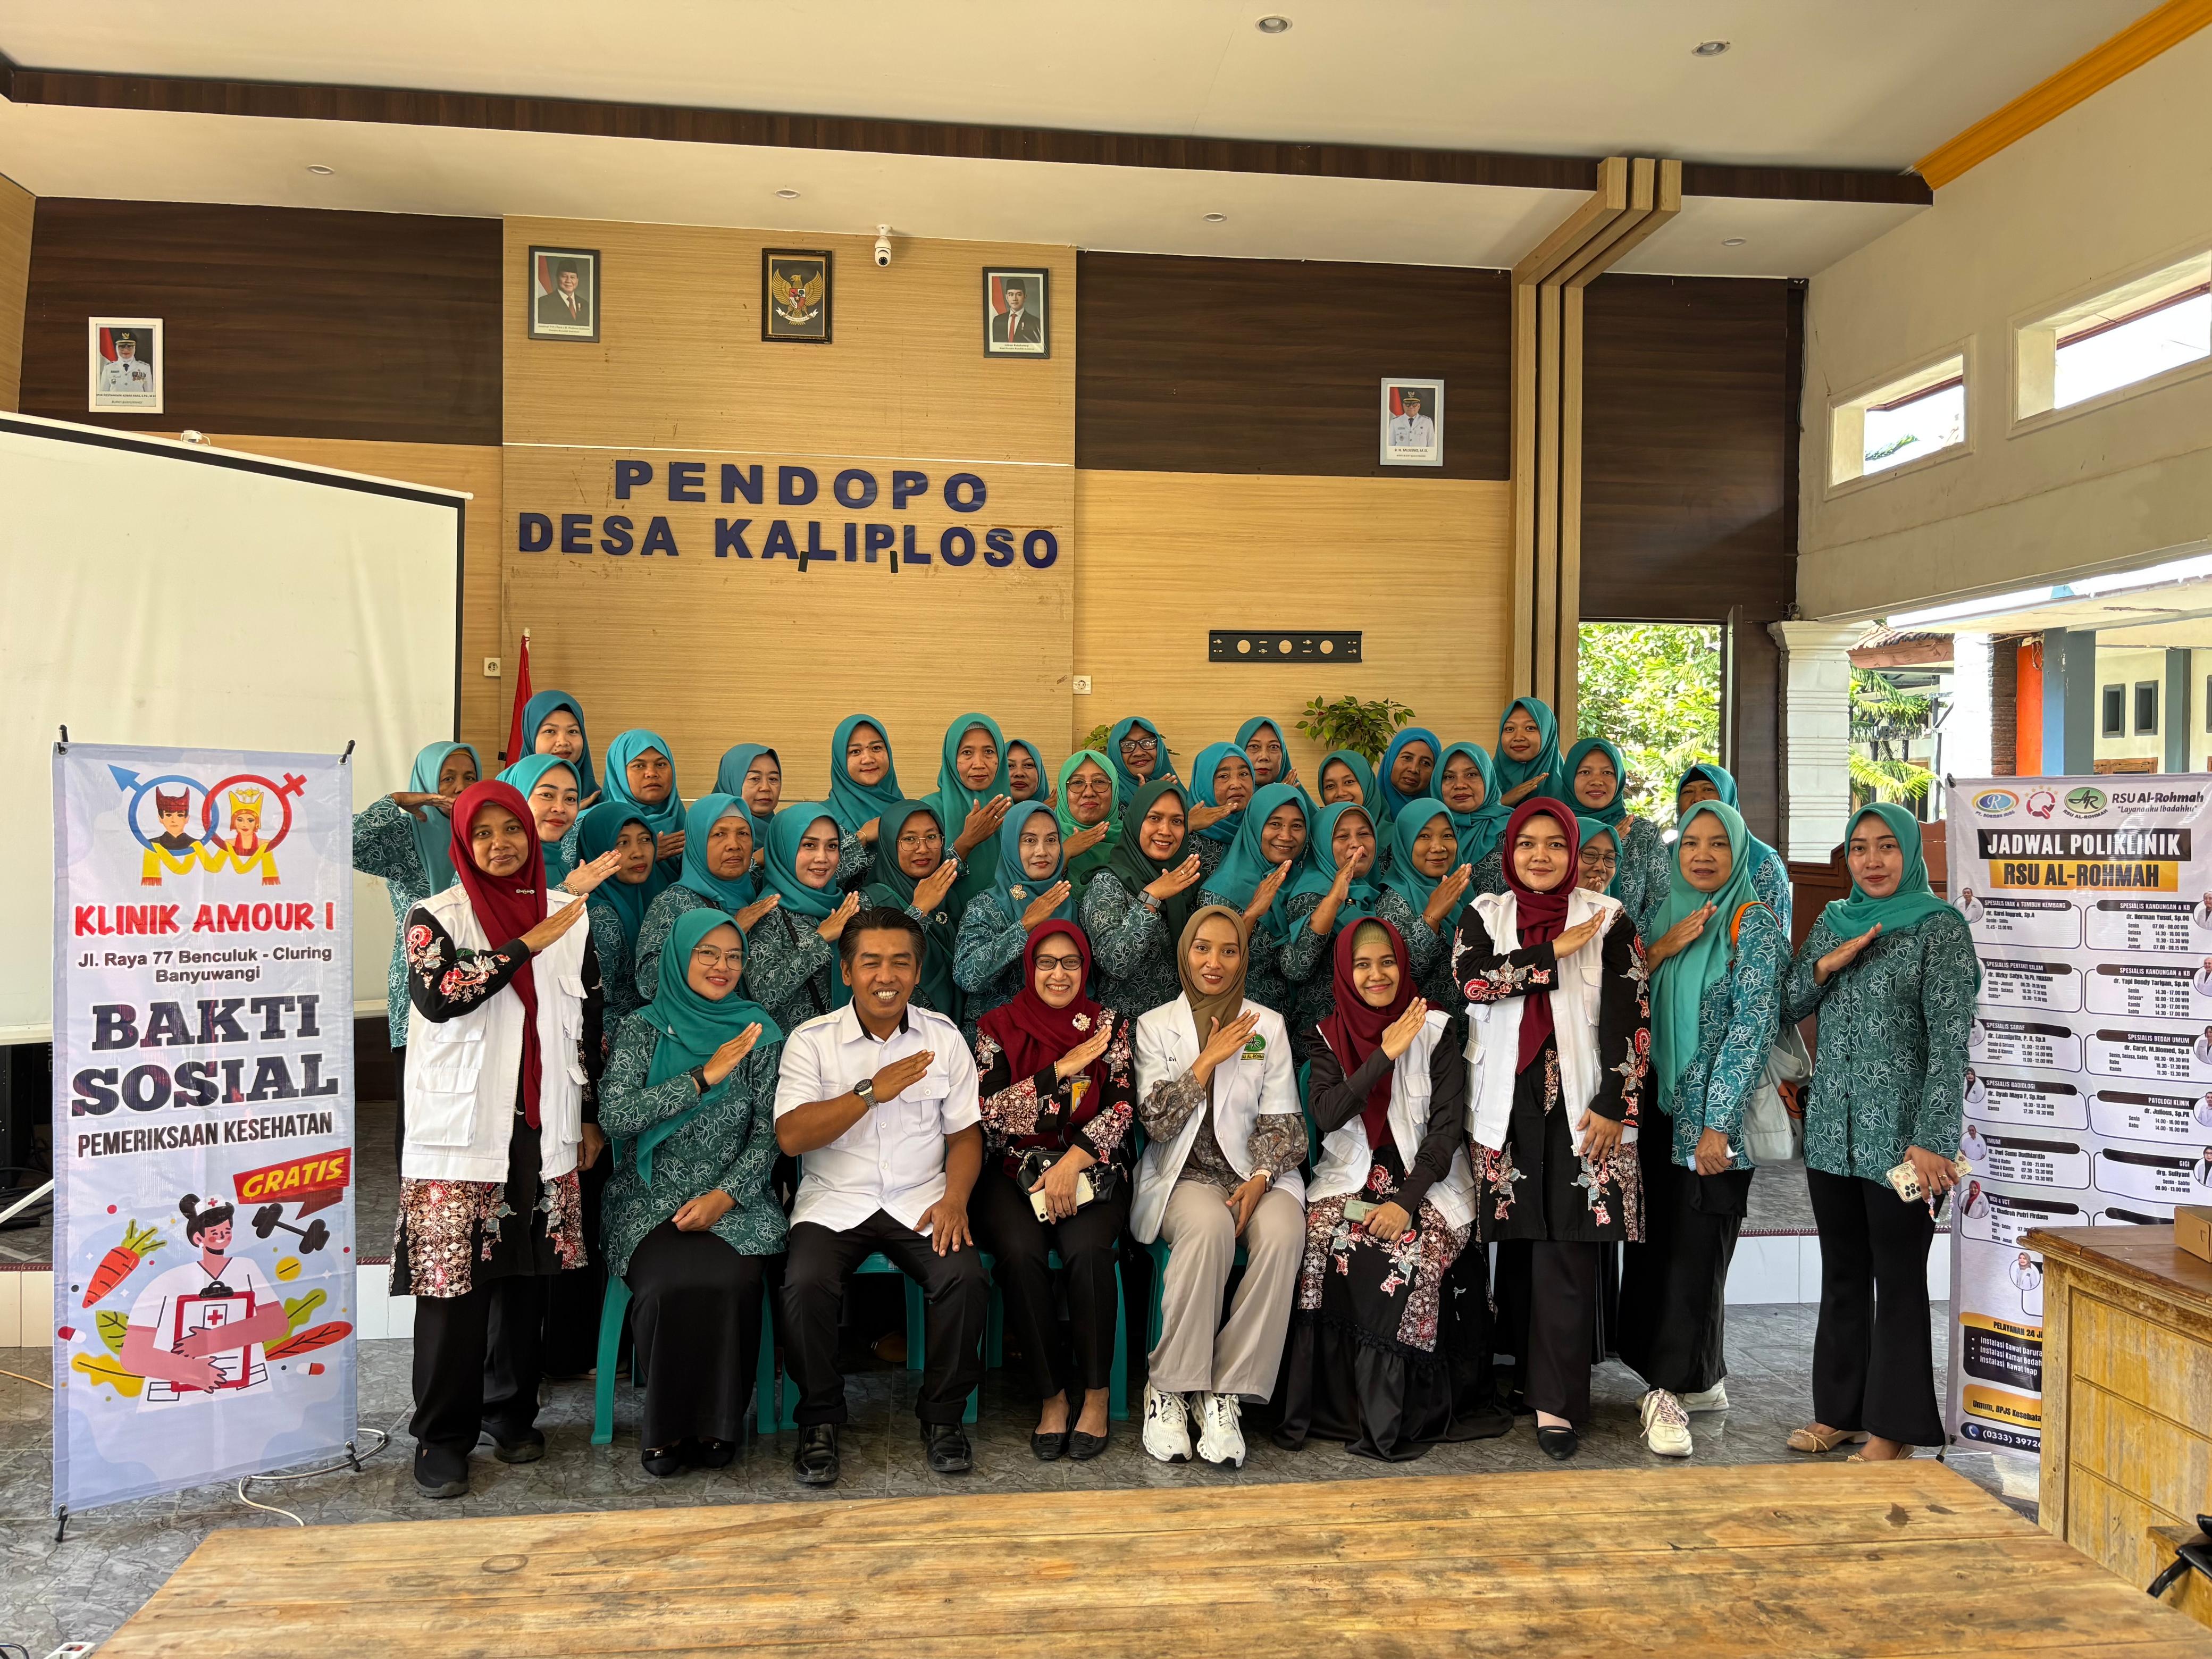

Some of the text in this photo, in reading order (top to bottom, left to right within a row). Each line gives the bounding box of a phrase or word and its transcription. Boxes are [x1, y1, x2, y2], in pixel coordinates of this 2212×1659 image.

[615, 459, 986, 513] PENDOPO
[518, 512, 1058, 568] DESA KALIPLOSO
[2112, 792, 2204, 803] RSU Al-Rohmah
[1987, 834, 2180, 855] JADWAL POLIKLINIK
[2004, 864, 2159, 887] RSU AL-ROHMAH
[74, 902, 334, 937] KLINIK AMOUR I
[78, 953, 99, 968] Jl.
[105, 952, 147, 969] Raya
[153, 951, 172, 965] 77
[179, 949, 258, 964] Benculuk
[273, 947, 332, 962] Cluring
[156, 967, 260, 984] Banyuwangi
[92, 995, 320, 1051] BAKTI
[71, 1053, 339, 1117] SOSIAL
[78, 1112, 332, 1158] PEMERIKSAAN KESEHATAN
[242, 1157, 345, 1198] GRATIS
[1993, 1321, 2025, 1335] PELAYANAN
[1981, 1337, 2004, 1348] Instalasi
[2006, 1343, 2021, 1354] Gawat
[1980, 1346, 2042, 1367] Instalasi Kamar Bedah
[1980, 1355, 2038, 1376] Instalasi Rawat Inap
[1996, 1405, 2010, 1415] BPJS
[1982, 1430, 2012, 1444] (0333)
